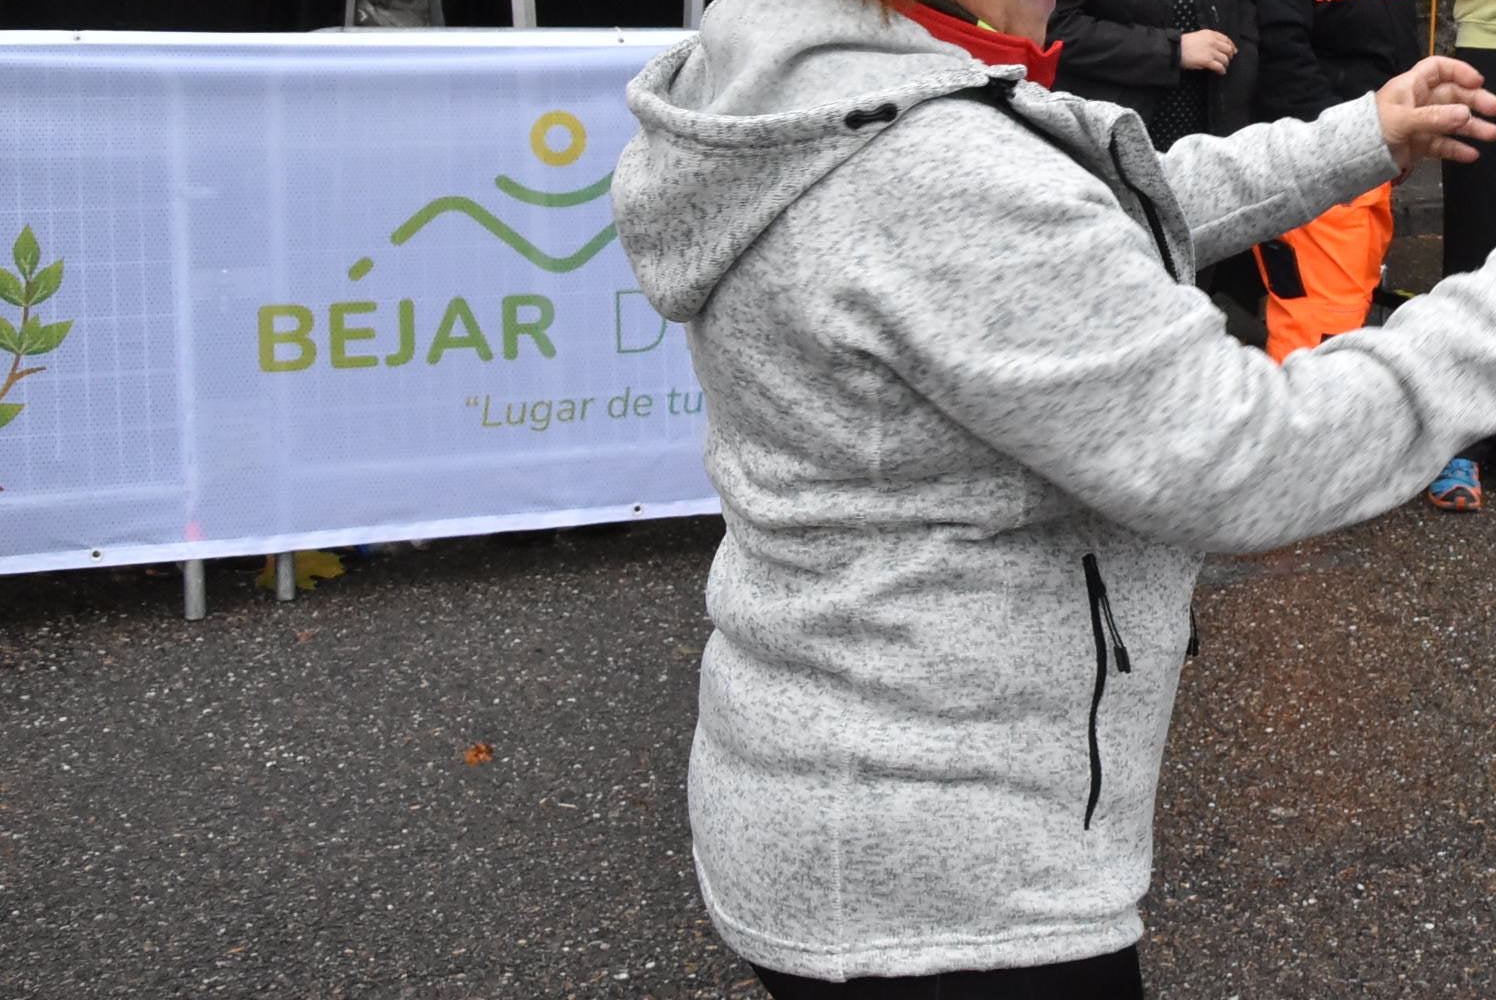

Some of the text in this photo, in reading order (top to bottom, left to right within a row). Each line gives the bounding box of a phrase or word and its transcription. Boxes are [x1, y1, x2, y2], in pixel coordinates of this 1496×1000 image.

[257, 257, 556, 373] BÉJAR
[607, 386, 653, 419] de
[667, 386, 704, 416] tu
